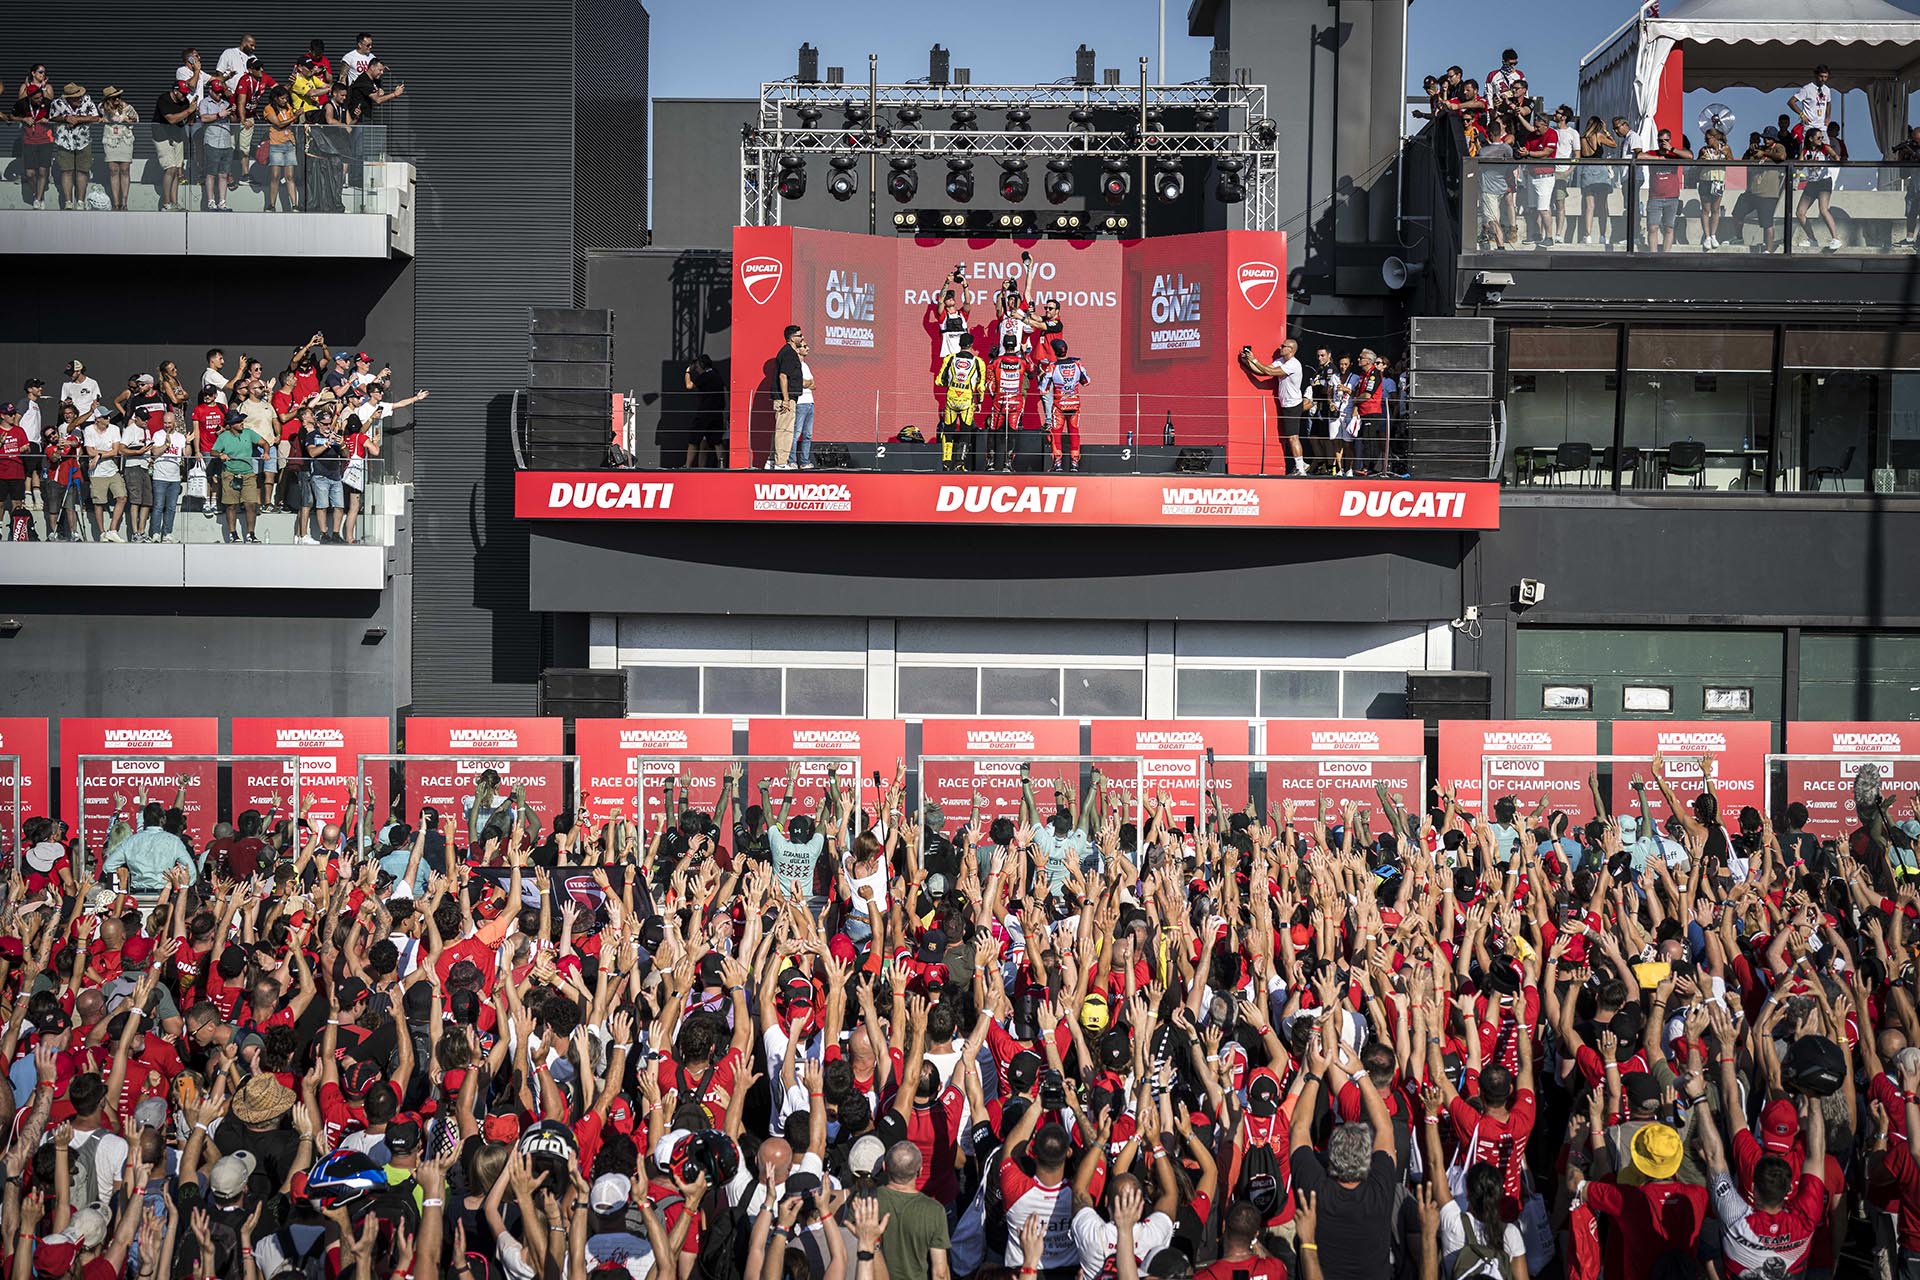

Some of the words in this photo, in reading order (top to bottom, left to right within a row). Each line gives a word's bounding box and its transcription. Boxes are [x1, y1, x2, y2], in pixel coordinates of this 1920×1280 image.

[826, 270, 862, 292] ALL
[1152, 272, 1189, 296] ALL
[993, 290, 1117, 307] CMPIONS
[826, 291, 875, 321] ONE
[1152, 294, 1200, 324] ONE
[825, 326, 874, 340] WDW2024
[1151, 328, 1200, 342] WDW2024
[876, 446, 886, 458] 2
[1121, 449, 1131, 460] 3
[548, 482, 674, 509] DUCATI
[754, 484, 851, 500] WDW2024
[1162, 488, 1259, 505] WDW2024
[936, 486, 1077, 512] DUCATI
[1340, 490, 1466, 517] DUCATI
[104, 730, 172, 740] WDW2024
[276, 730, 344, 740] WDW2024
[450, 730, 518, 740] WDW2024
[619, 730, 687, 741] WDW2024
[793, 731, 860, 741] WDW2024
[967, 731, 1034, 742] WDW2024
[1136, 732, 1204, 743] WDW2024
[1311, 732, 1379, 743] WDW2024
[1484, 732, 1552, 743] WDW2024
[1658, 733, 1726, 744] WDW2024
[1832, 734, 1901, 745] WDW2024
[117, 761, 160, 770] Lenovo
[288, 760, 331, 769] Lnovo
[632, 761, 675, 770] Lnovo
[805, 762, 847, 770] Leno
[1148, 763, 1191, 772] Lenovo
[1324, 762, 1367, 771] Lenovo
[1496, 761, 1539, 770] Lenovo
[1670, 762, 1714, 772] Leno
[1846, 763, 1888, 774] Leo
[109, 777, 125, 786] OF
[248, 776, 278, 786] RACE
[300, 777, 372, 786] CHAMPS
[421, 777, 452, 786] RACE
[454, 777, 470, 786] OF
[473, 777, 546, 786] CMPIONS
[591, 777, 622, 787] RACE
[643, 777, 716, 787] CHAONS
[797, 778, 813, 787] OF
[816, 778, 889, 787] CHMIOS
[938, 778, 969, 788] RACE
[972, 778, 988, 788] OF
[990, 778, 1055, 788] CHAMON
[1107, 779, 1136, 789] RACE
[1142, 779, 1157, 789] OF
[1162, 779, 1232, 789] CHAMONS
[1282, 779, 1313, 788] RACE
[1316, 779, 1332, 788] OF
[1335, 779, 1408, 789] CHAMPONS
[1489, 780, 1504, 789] OF
[1507, 780, 1581, 790] CHAMPIONS
[1681, 780, 1754, 790] CHAPIONS
[1804, 781, 1835, 790] RACE
[1838, 781, 1854, 790] OF
[1758, 1233, 1791, 1244] TEAM
